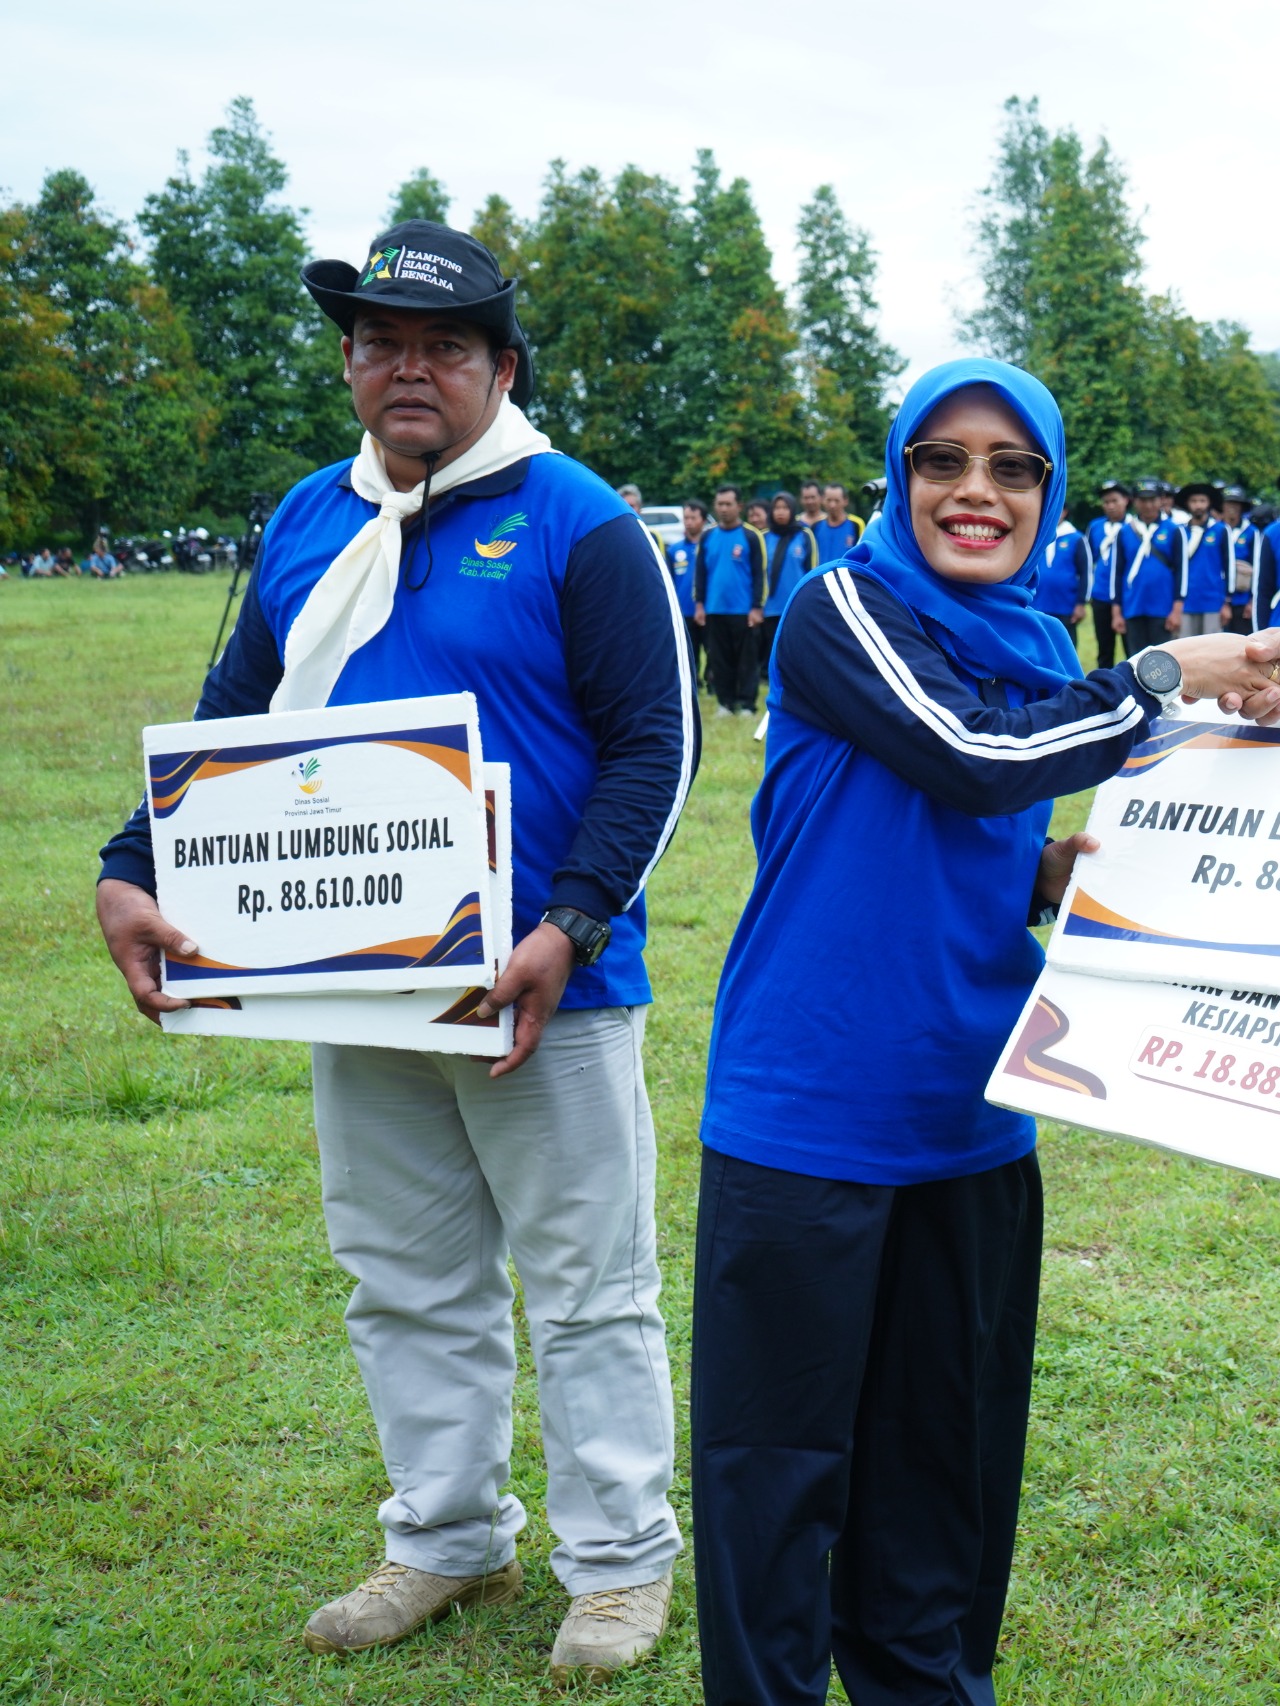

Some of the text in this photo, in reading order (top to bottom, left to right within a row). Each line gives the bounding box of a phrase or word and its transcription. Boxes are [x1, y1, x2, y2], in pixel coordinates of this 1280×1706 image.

[402, 260, 439, 274] SIAGA
[406, 250, 463, 274] KAMPUNG
[400, 269, 454, 292] BENCANA
[459, 566, 508, 580] Kab. Kediri
[461, 556, 513, 572] Dinas Sosial
[1119, 798, 1266, 838] BANTUAN
[174, 816, 455, 868] BANTUAN LUMBUNG SOSIAL
[1190, 853, 1243, 894] Rp.
[237, 872, 404, 922] Rp. 88.610.000
[1137, 1034, 1184, 1073] RP.
